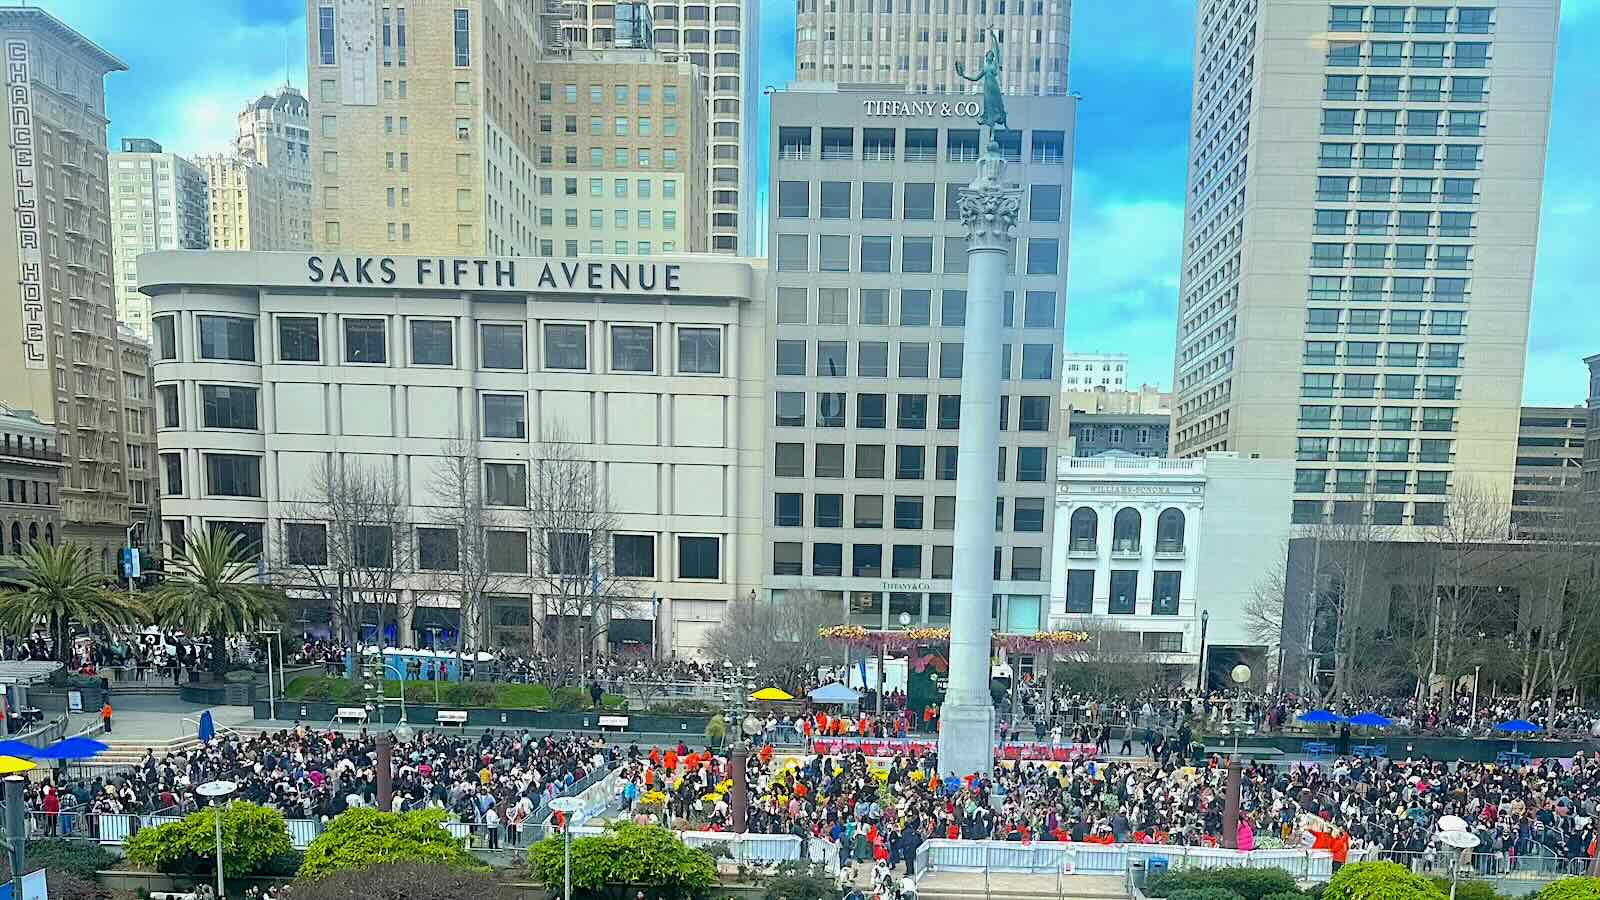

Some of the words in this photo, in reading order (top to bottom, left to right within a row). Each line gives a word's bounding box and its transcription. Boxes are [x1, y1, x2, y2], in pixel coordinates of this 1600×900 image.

[863, 100, 937, 116] TIFFANY
[940, 101, 952, 116] &
[8, 42, 37, 249] CHANCELLOR
[308, 256, 396, 284] SAKS
[417, 259, 515, 286] FIFTH
[538, 262, 680, 291] AVENUE
[22, 263, 44, 361] HOTEL
